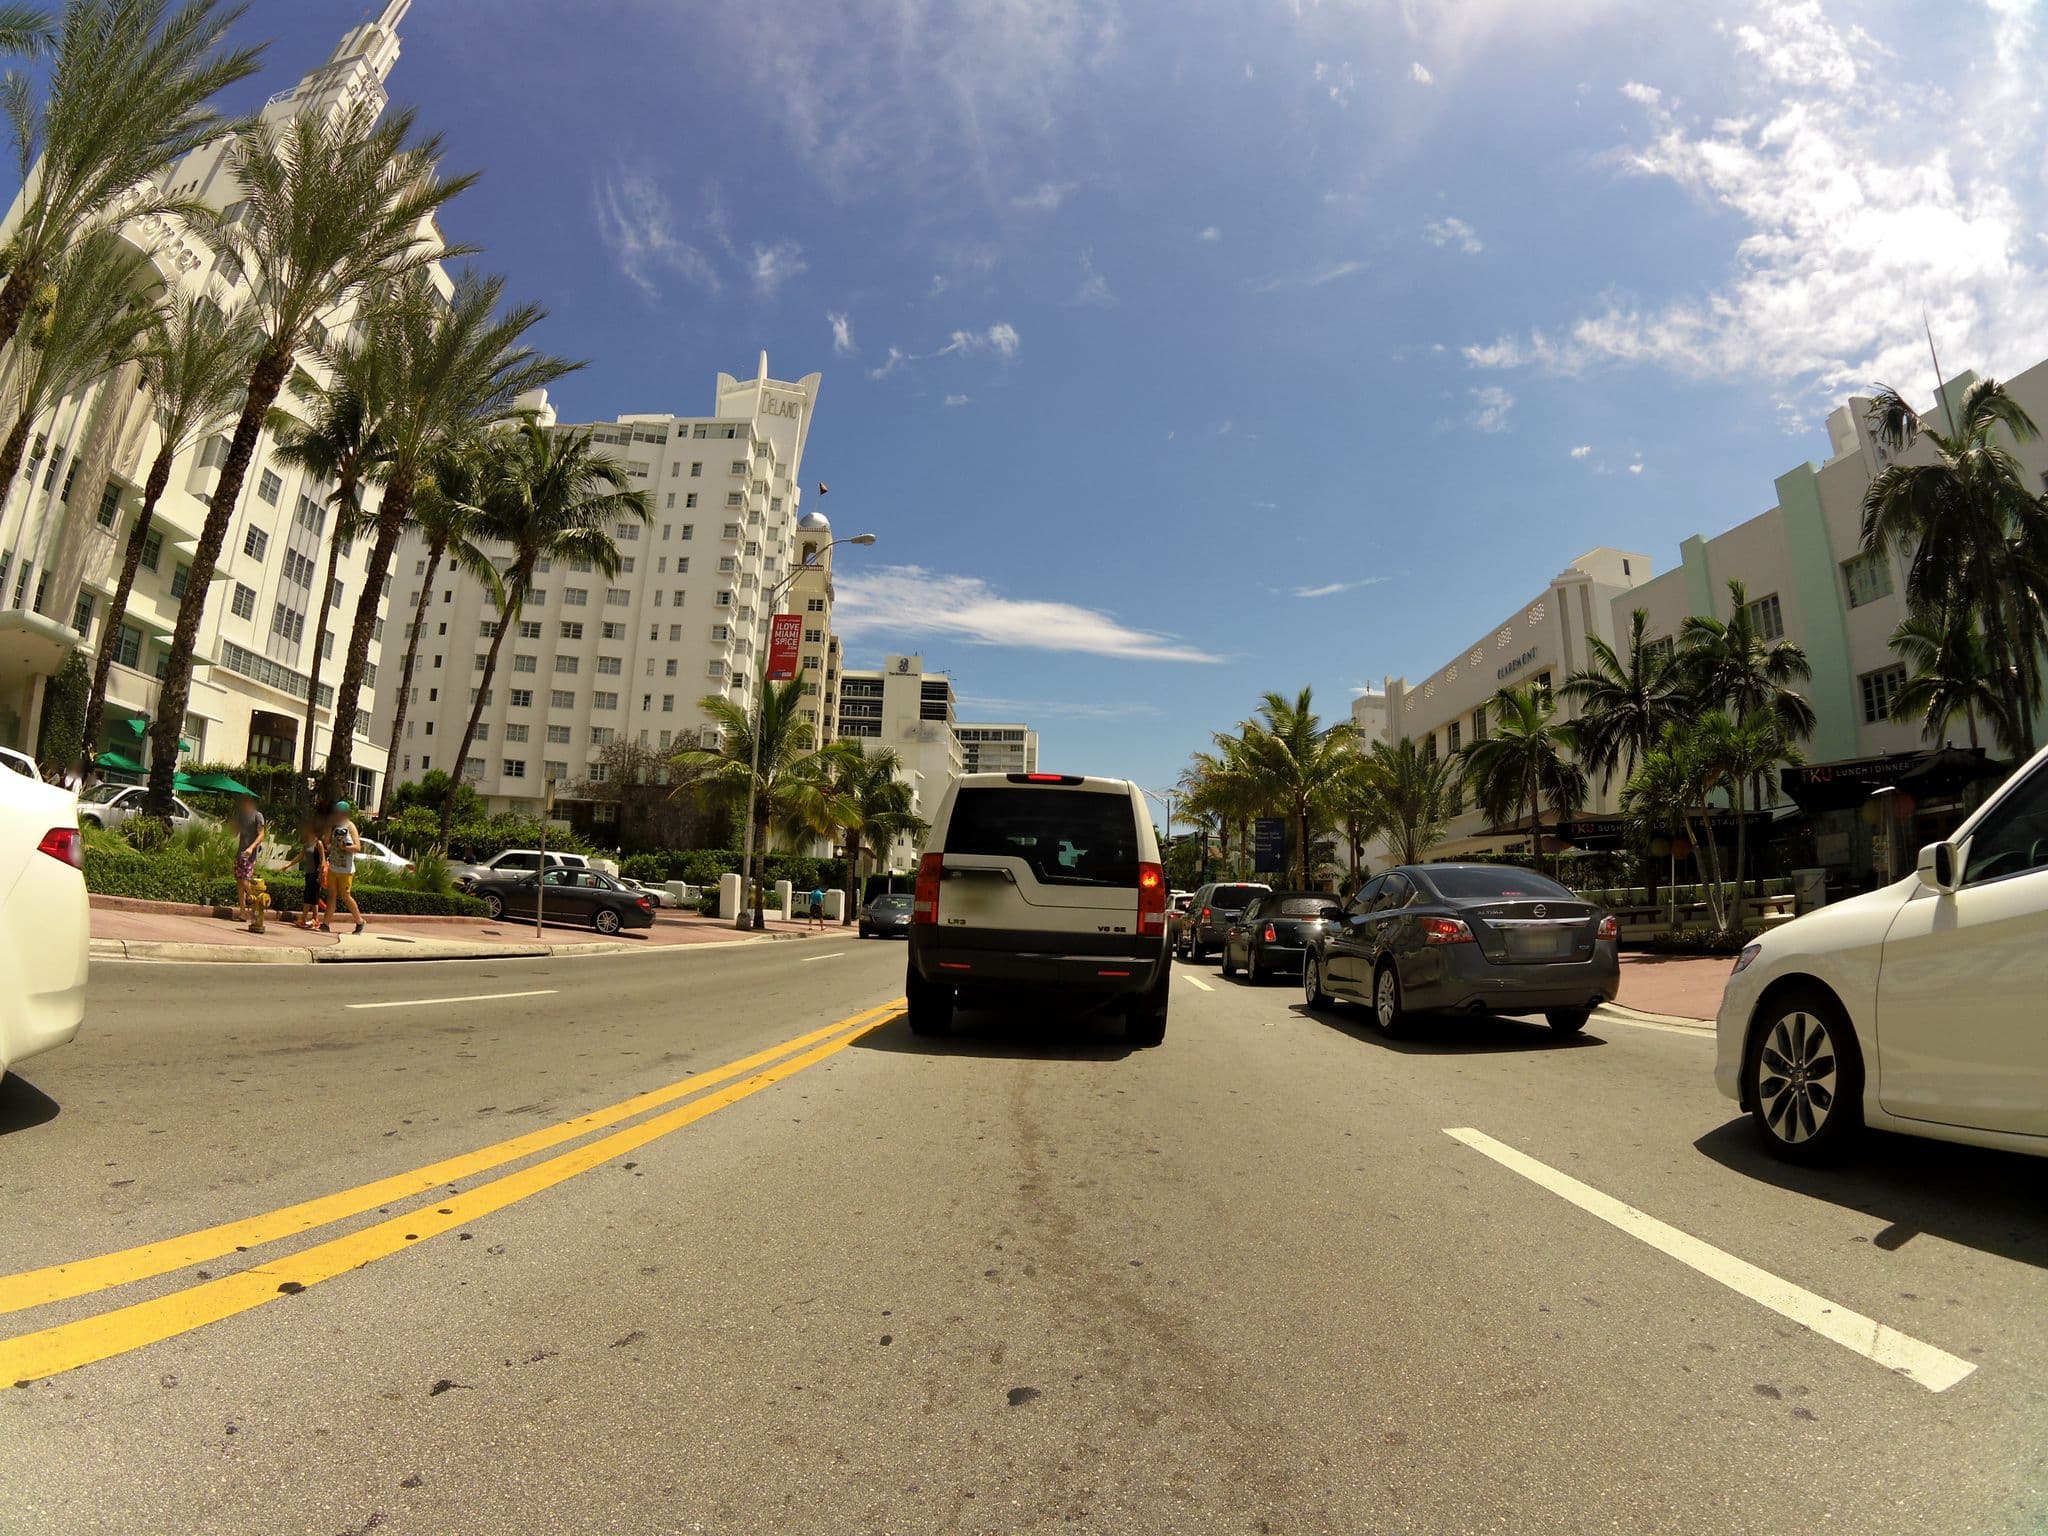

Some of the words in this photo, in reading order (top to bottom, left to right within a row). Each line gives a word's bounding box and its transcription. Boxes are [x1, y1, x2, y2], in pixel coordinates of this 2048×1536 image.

[762, 391, 799, 420] DELANO
[775, 630, 799, 638] MIAMI
[775, 638, 798, 646] SPICE
[1836, 767, 1868, 777] LUNCH
[1598, 822, 1624, 833] SUSH
[947, 917, 967, 925] LR3
